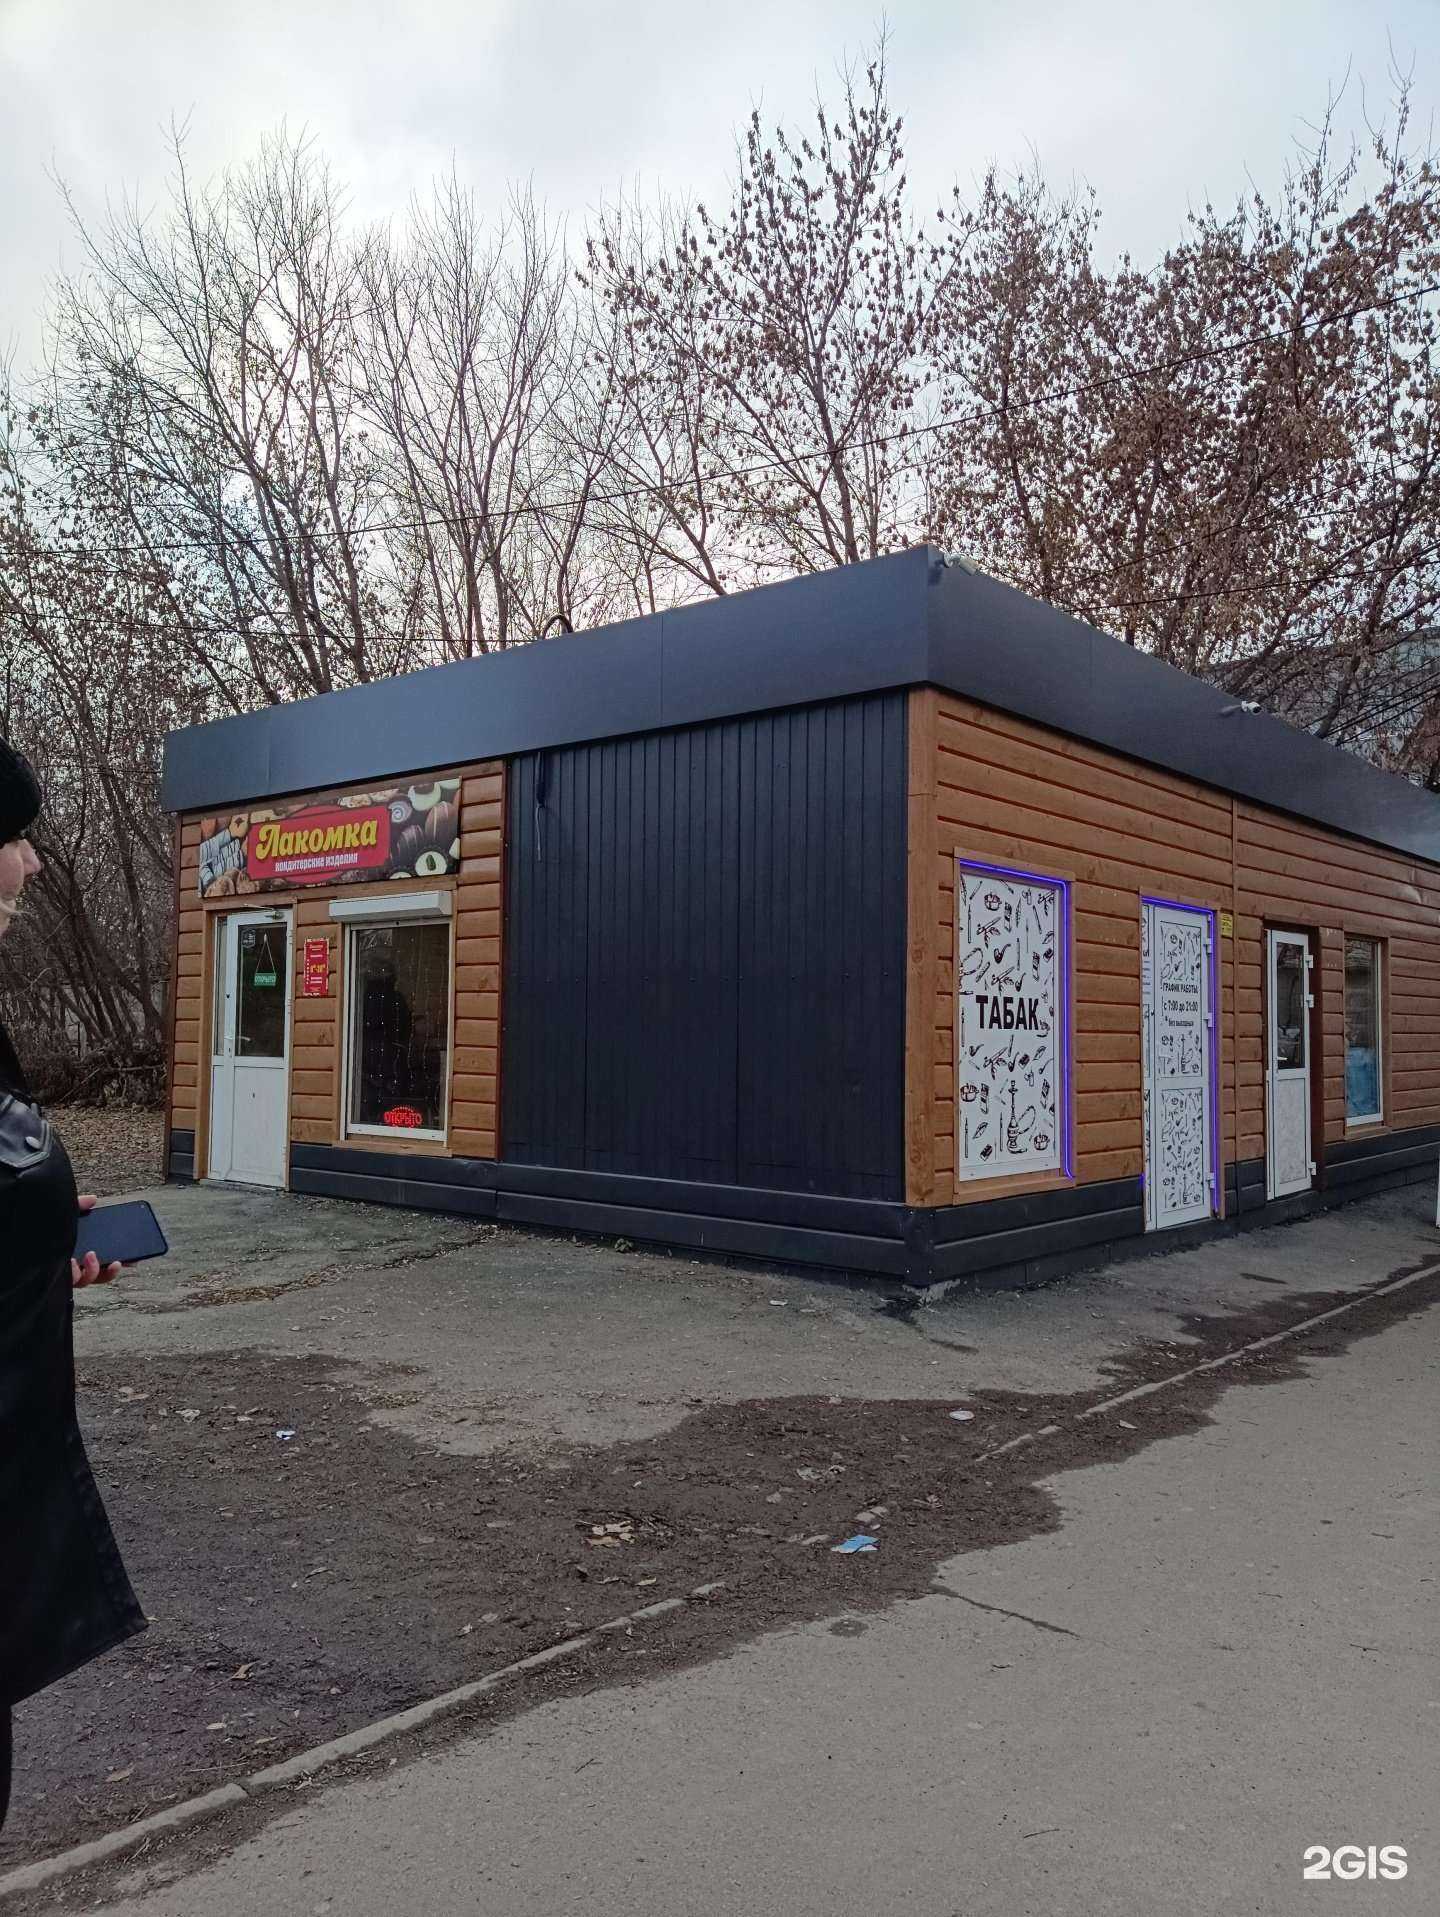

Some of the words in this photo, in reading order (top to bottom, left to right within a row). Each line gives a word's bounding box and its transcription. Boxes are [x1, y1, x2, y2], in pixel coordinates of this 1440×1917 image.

[256, 820, 377, 859] Лакомка
[1163, 982, 1180, 992] ГРАФИК
[976, 995, 1039, 1030] ТАБАК
[384, 1111, 422, 1124] ОТКРЫТО
